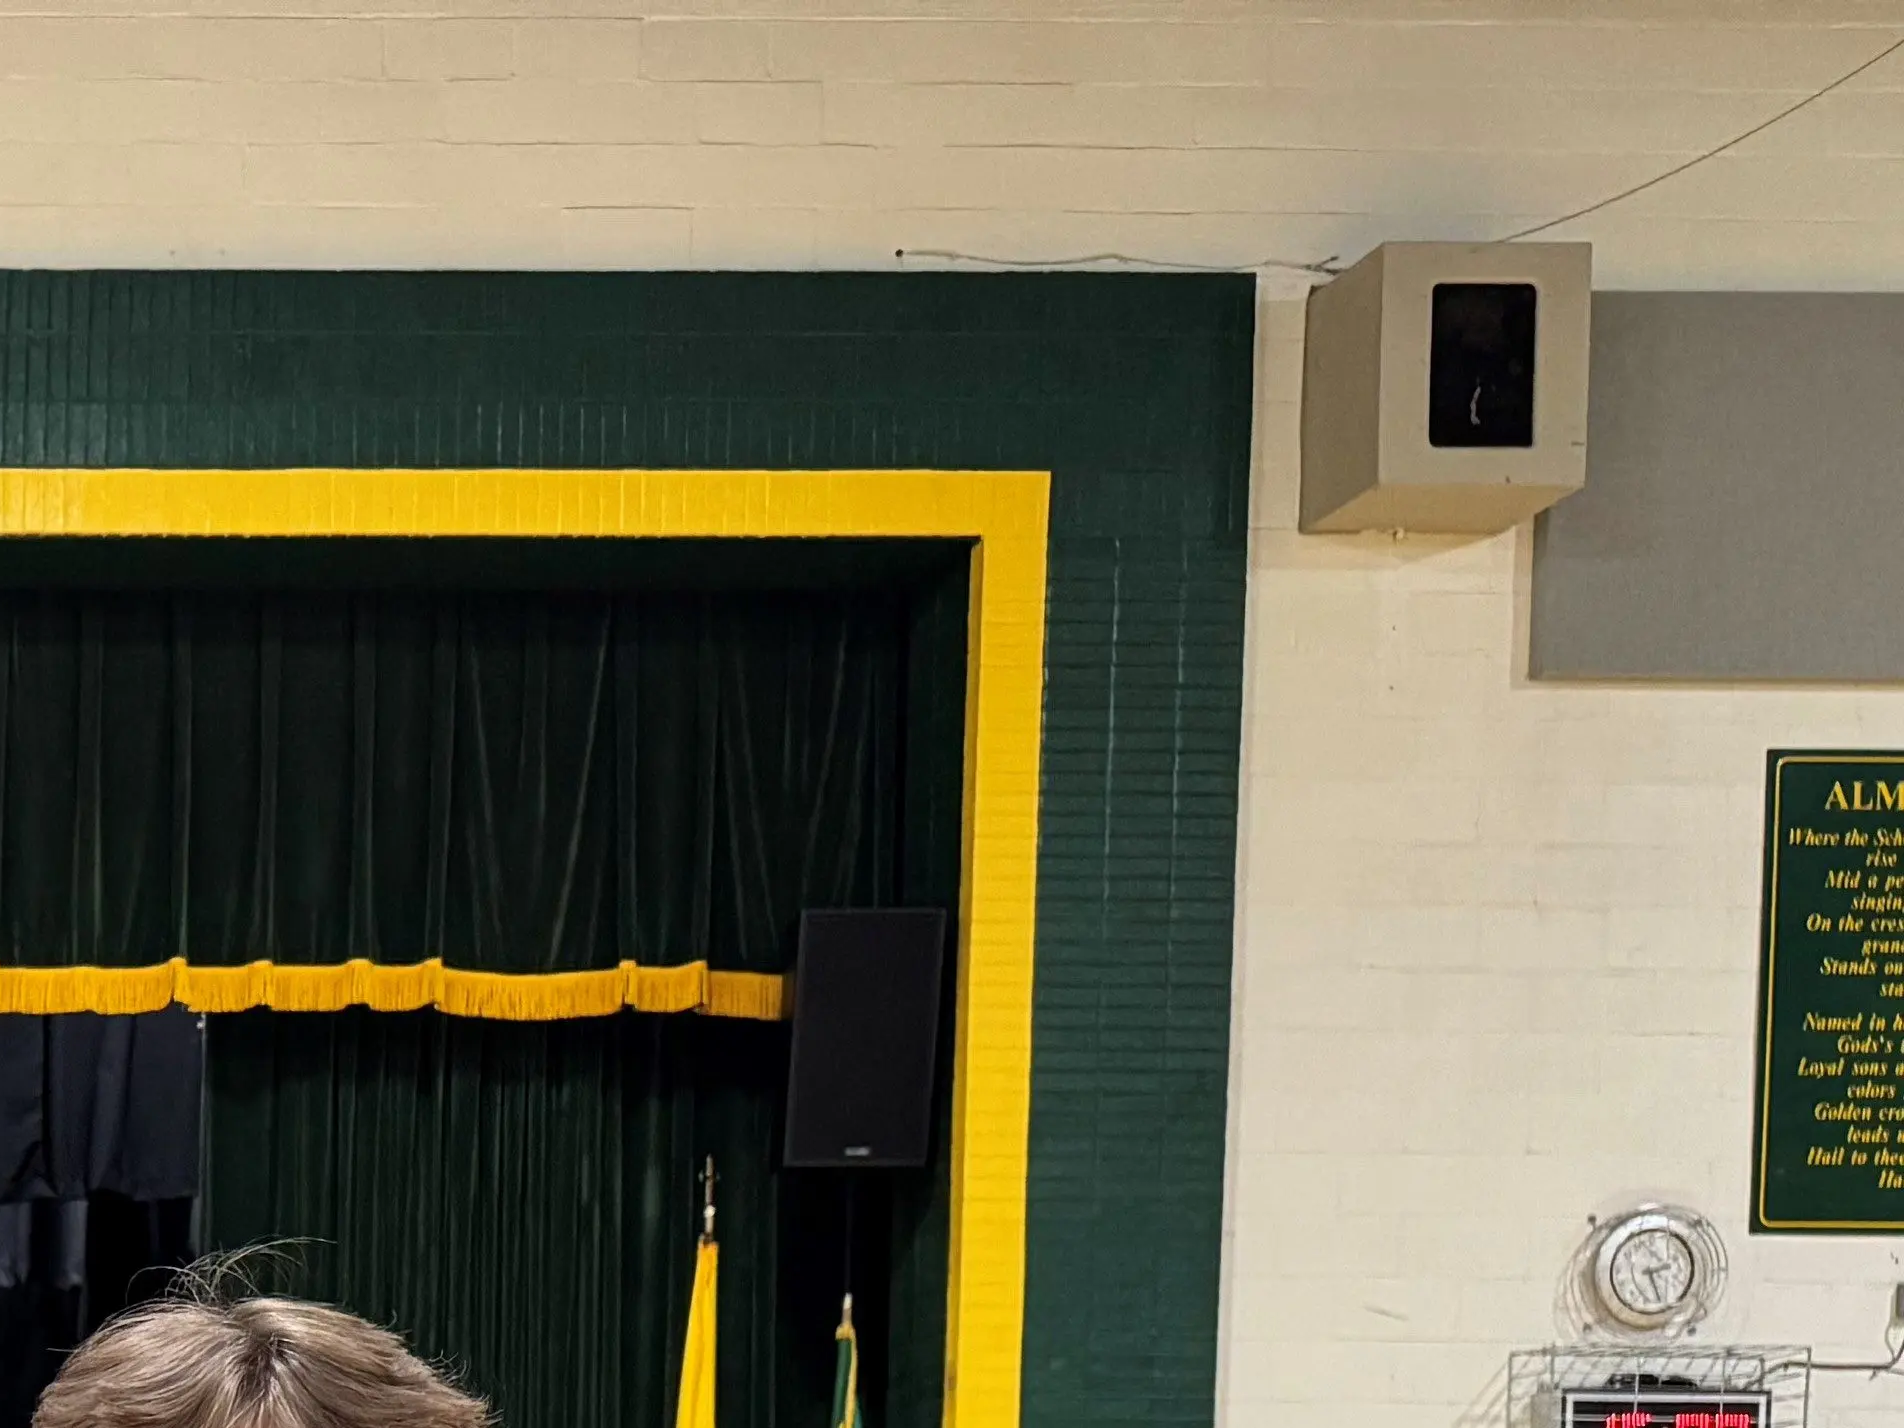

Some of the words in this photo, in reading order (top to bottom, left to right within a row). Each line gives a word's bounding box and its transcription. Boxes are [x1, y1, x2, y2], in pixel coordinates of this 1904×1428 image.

[1789, 827, 1840, 847] Where
[1845, 827, 1869, 847] the
[1825, 870, 1861, 889] Mid
[1806, 913, 1831, 932] On
[1838, 912, 1864, 932] the
[1820, 956, 1878, 976] Stands
[1803, 1012, 1863, 1031] Named
[1869, 1012, 1887, 1031] in
[1798, 1056, 1845, 1079] Loyal
[1852, 1062, 1889, 1076] sons
[1847, 1080, 1896, 1098] colors
[1815, 1102, 1872, 1120] Golden
[1848, 1124, 1890, 1143] leads
[1807, 1146, 1845, 1166] Hail
[1851, 1150, 1868, 1165] to
